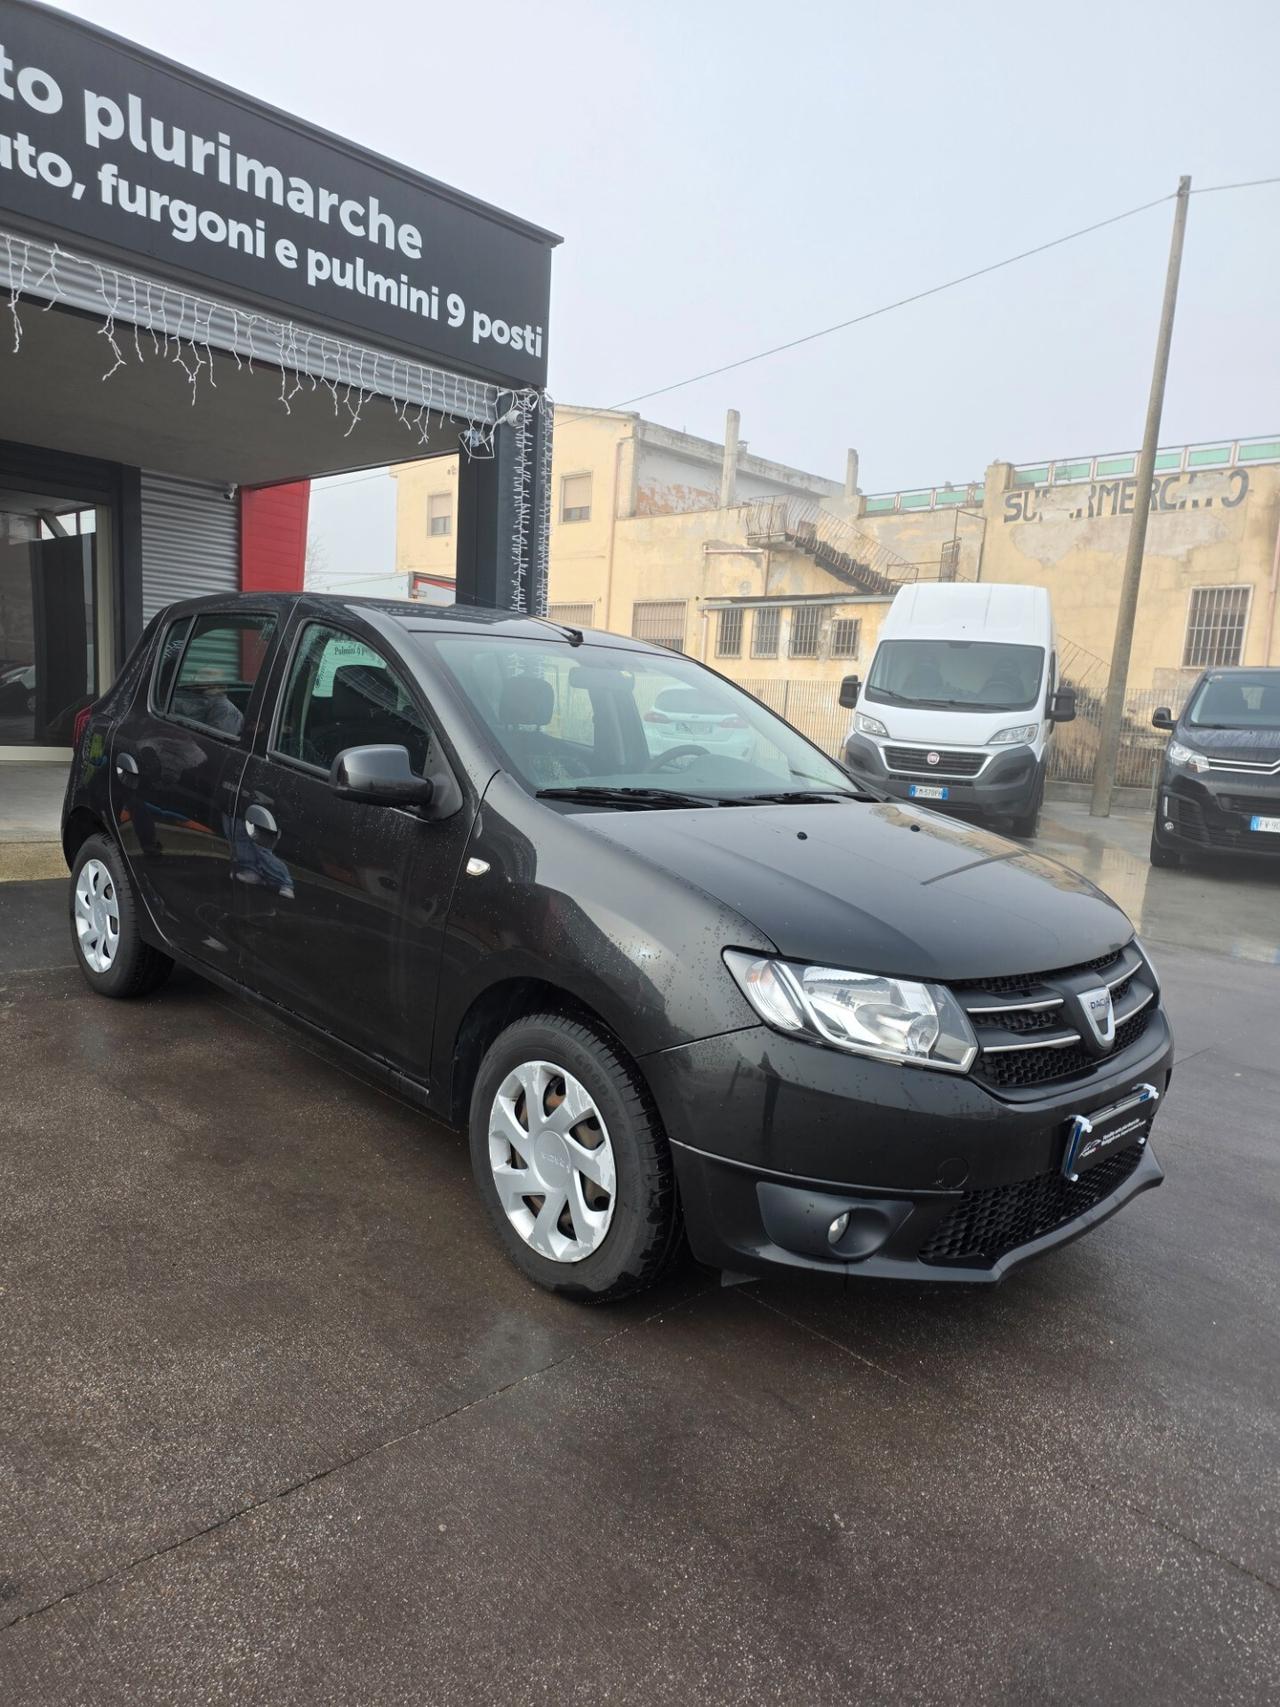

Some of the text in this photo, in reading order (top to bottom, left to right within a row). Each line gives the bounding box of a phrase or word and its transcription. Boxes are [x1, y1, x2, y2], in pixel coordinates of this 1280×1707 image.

[84, 88, 423, 260] plurimarche
[97, 162, 266, 260] furgoni
[274, 238, 299, 270] e
[307, 247, 439, 321] pulmini
[446, 292, 466, 329] 9
[472, 309, 543, 358] posti
